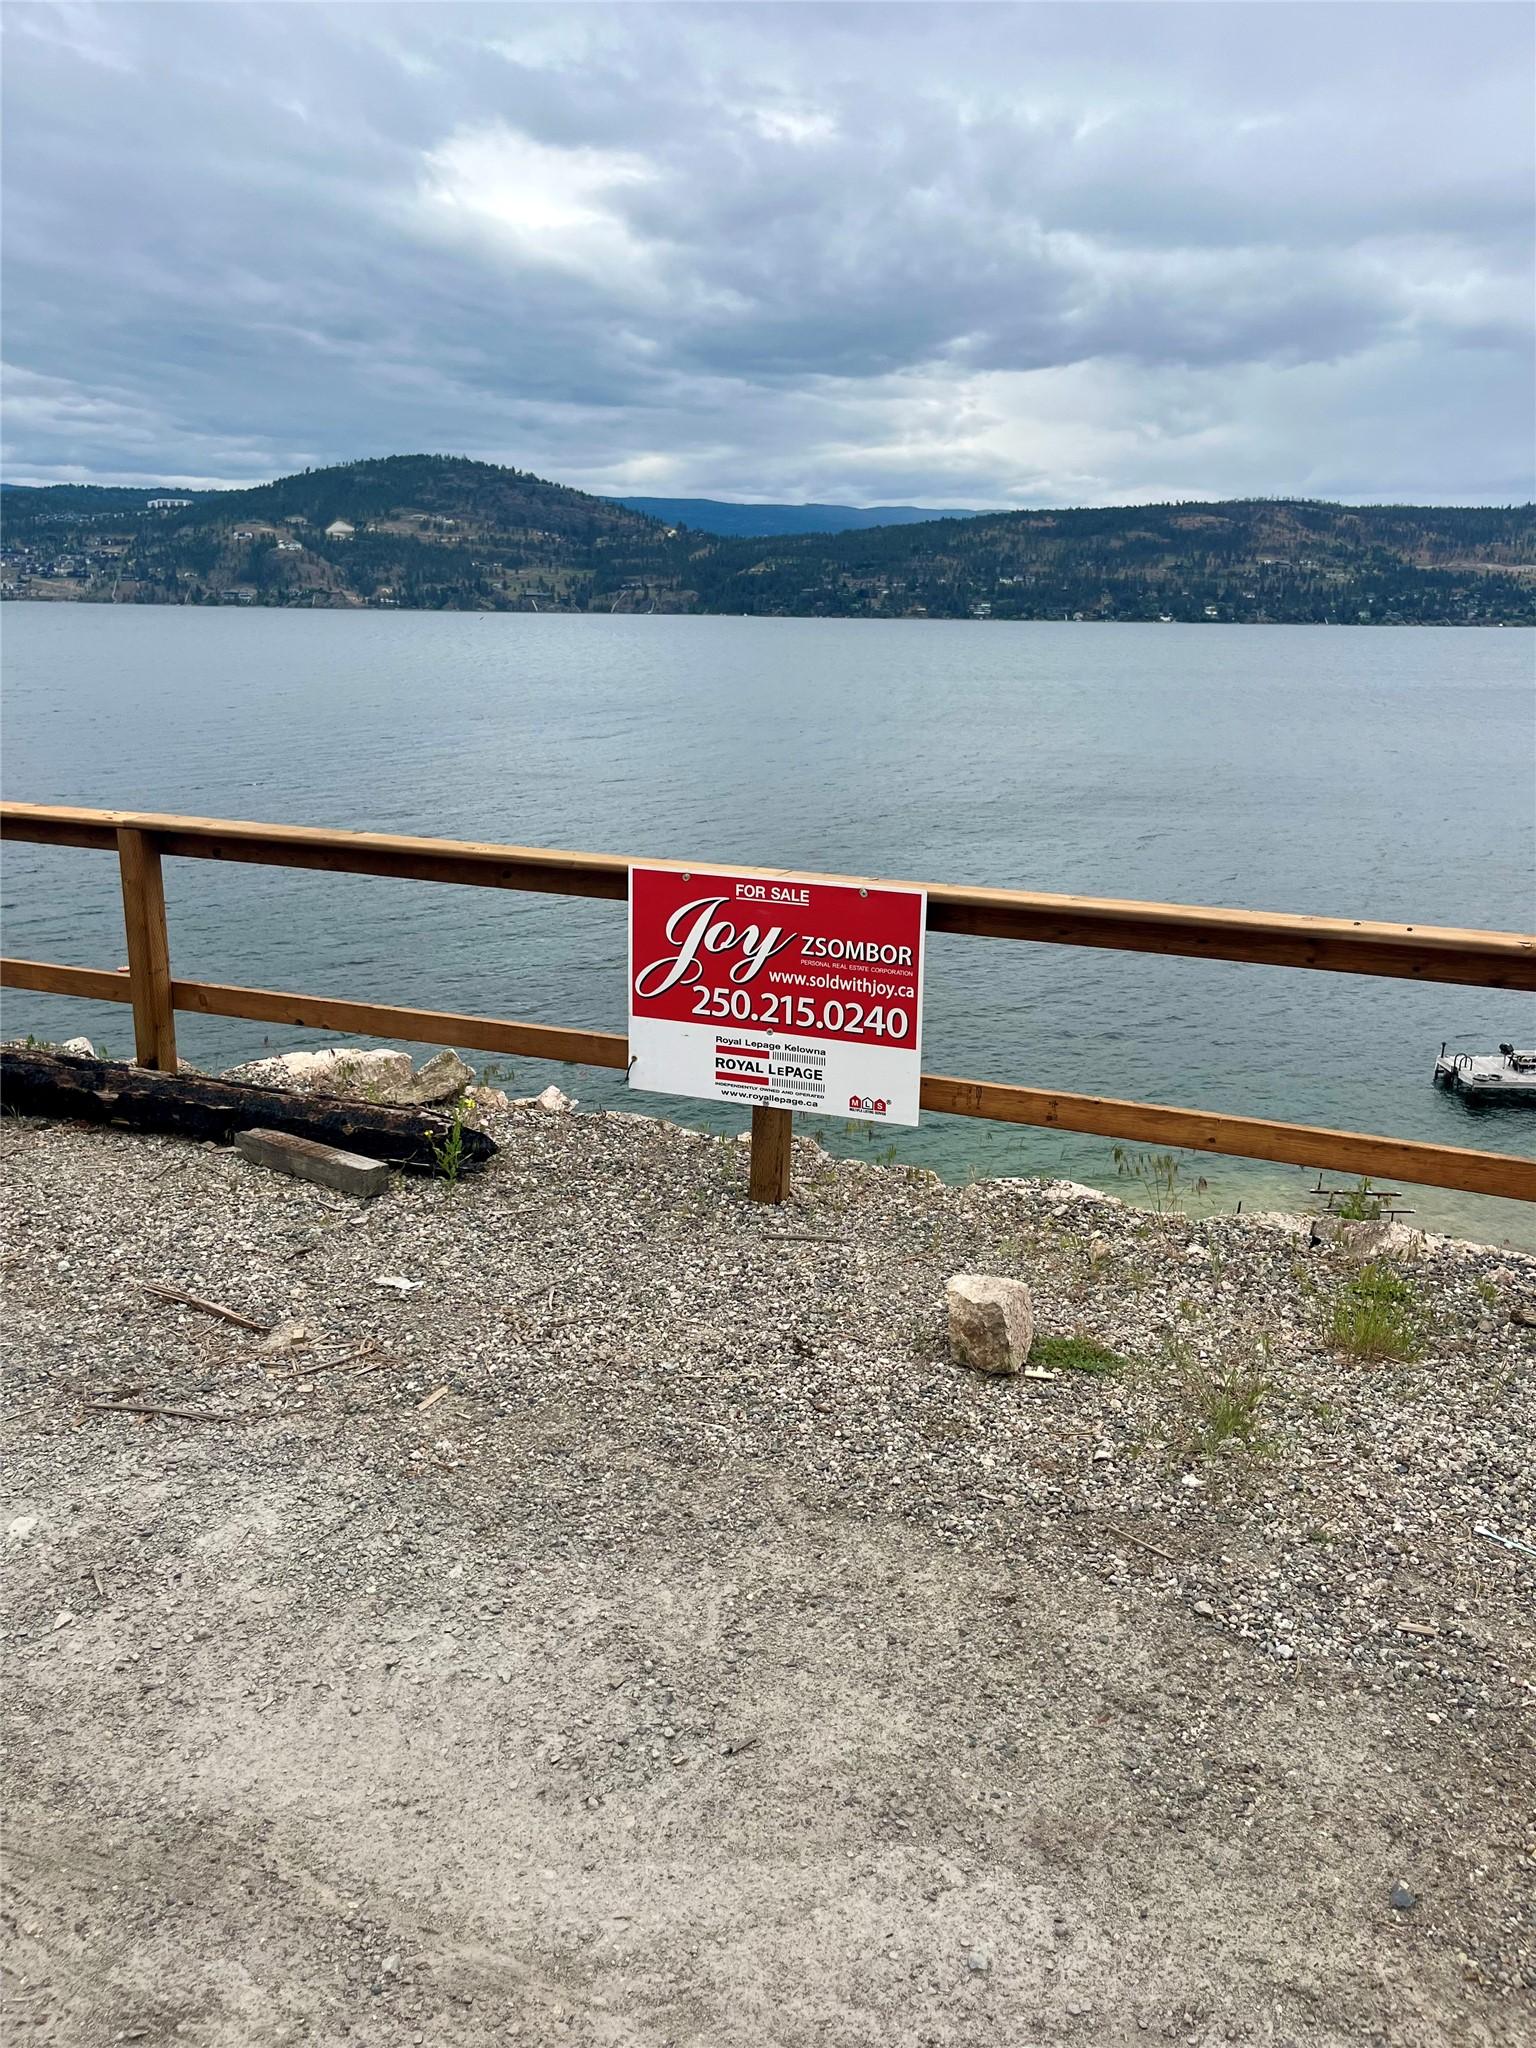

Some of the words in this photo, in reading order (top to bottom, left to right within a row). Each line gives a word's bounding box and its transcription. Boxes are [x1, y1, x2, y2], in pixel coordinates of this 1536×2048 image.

[736, 884, 766, 899] FOR
[771, 887, 810, 903] SALE
[634, 896, 797, 998] Joy
[801, 936, 912, 966] ZSOMBOR
[800, 959, 831, 968] PERSONAL
[832, 962, 848, 970] REAL
[849, 963, 870, 972] ESTATE
[871, 967, 913, 977] CORPORATION
[769, 971, 914, 1000] www.soldwithjoy.ca
[692, 986, 908, 1039] 250.215.0240
[716, 1036, 742, 1046] Royal
[745, 1039, 781, 1050] Lepage
[784, 1044, 826, 1056] Kelowna
[715, 1058, 764, 1073] ROYAL
[715, 1082, 758, 1090] INDEPENDENTLY
[721, 1089, 818, 1108] www.royallepage.ca
